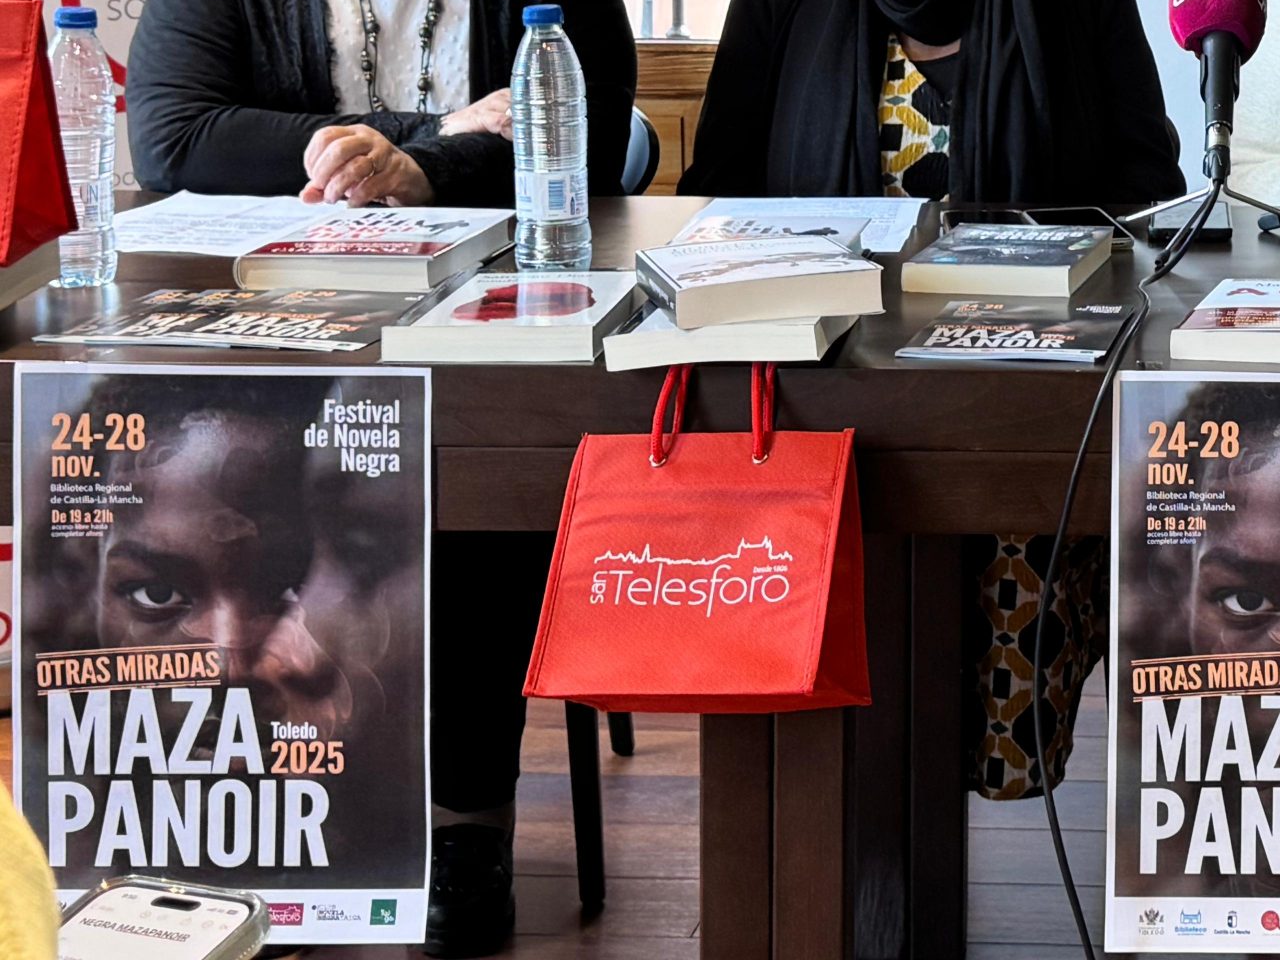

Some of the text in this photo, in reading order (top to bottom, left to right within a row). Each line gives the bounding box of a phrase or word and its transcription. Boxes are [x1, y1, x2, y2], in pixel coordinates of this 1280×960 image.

[194, 323, 341, 339] PANOIR
[217, 313, 327, 329] MAZA
[923, 337, 1066, 348] PANOIR
[931, 328, 1036, 340] MAZA
[323, 398, 400, 424] Festival
[51, 413, 146, 451] 24-28
[304, 424, 400, 449] de Novela
[1147, 420, 1240, 459] 24-28
[51, 454, 100, 478] nov.
[340, 448, 400, 478] Negra
[1147, 462, 1195, 486] nov.
[50, 482, 132, 494] Biblioteca Regional
[50, 495, 144, 504] de Castilla-La Mancha
[1146, 490, 1226, 502] Biblioteca Regional
[51, 509, 113, 524] De 19 a 21h
[1146, 502, 1236, 512] de Castilla-La Mancha
[1147, 516, 1207, 531] De 19 a 21h
[590, 563, 790, 618] san Telesforo
[36, 649, 221, 688] OTRAS MIRADAS
[1132, 664, 1202, 695] OTRAS
[47, 687, 265, 776] MAZA
[270, 721, 318, 741] Toledo
[270, 740, 345, 775] 2025
[47, 779, 330, 869] PANOIR
[79, 917, 191, 942] NEGRA MAZAPANOIR
